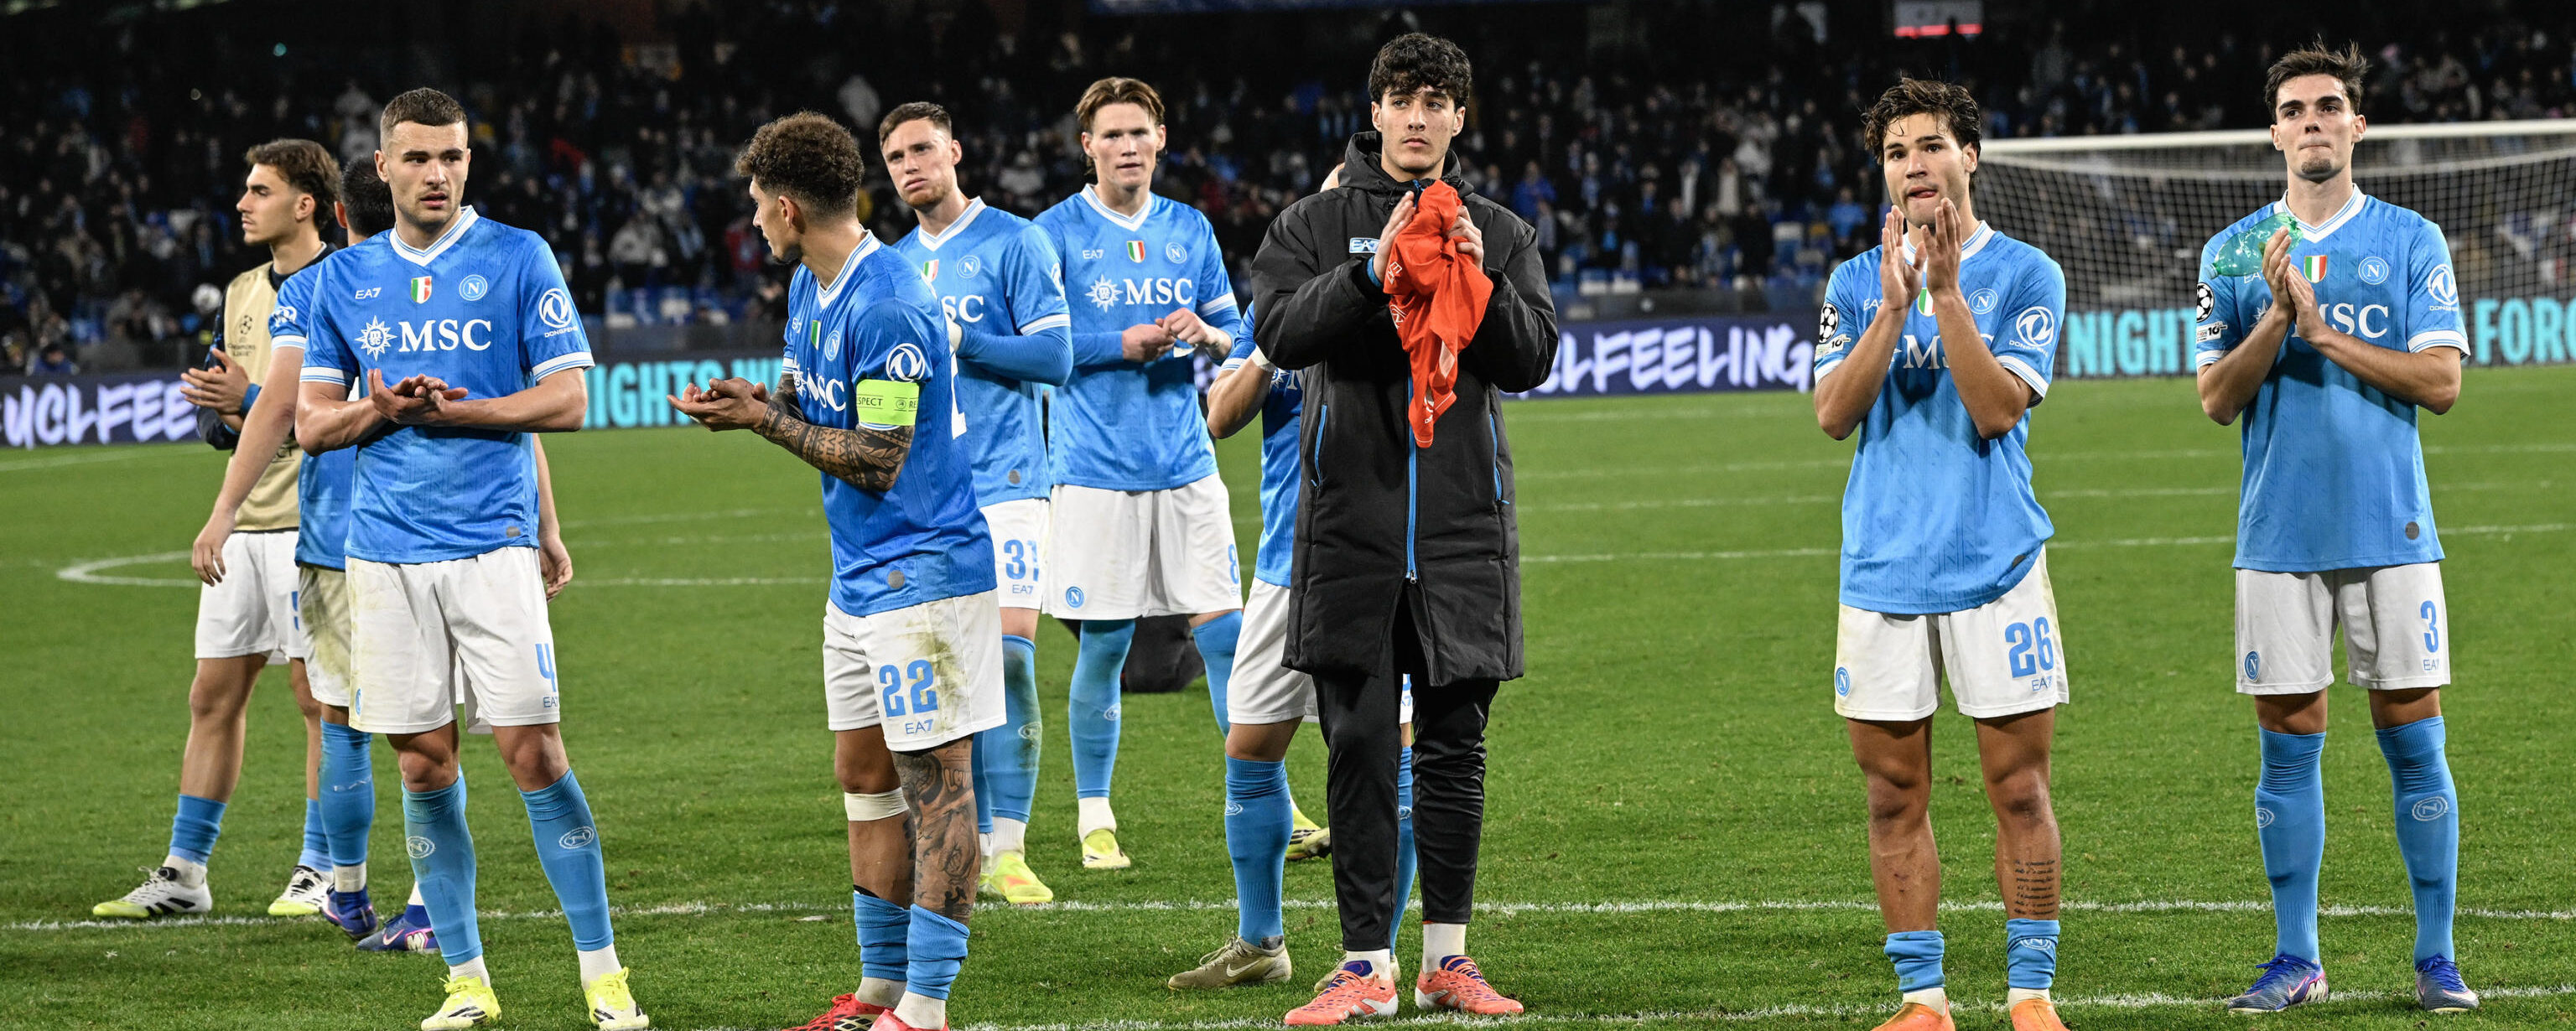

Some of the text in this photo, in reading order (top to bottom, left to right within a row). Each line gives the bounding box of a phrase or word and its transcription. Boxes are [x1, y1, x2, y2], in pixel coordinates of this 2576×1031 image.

[1082, 249, 1104, 260] EA7
[1171, 248, 1182, 258] N
[964, 261, 974, 272] N
[2366, 264, 2380, 277] N
[2243, 271, 2266, 284] EA
[355, 287, 382, 300] EA7
[466, 282, 480, 294] N
[1123, 277, 1193, 305] MSC
[1976, 295, 1991, 308] N
[941, 294, 984, 324] SC
[398, 319, 491, 353] MSC
[1530, 322, 1814, 396] LFEELING
[908, 400, 919, 408] RE
[1228, 544, 1239, 584] 8
[1011, 583, 1034, 594] EA7
[1070, 590, 1080, 603] N
[2420, 600, 2439, 653] 3
[2004, 616, 2054, 678] 26
[535, 643, 557, 692] 4
[879, 659, 938, 718] 22
[2031, 675, 2053, 692] EA7
[543, 696, 558, 708] EA
[905, 718, 934, 735] EA7
